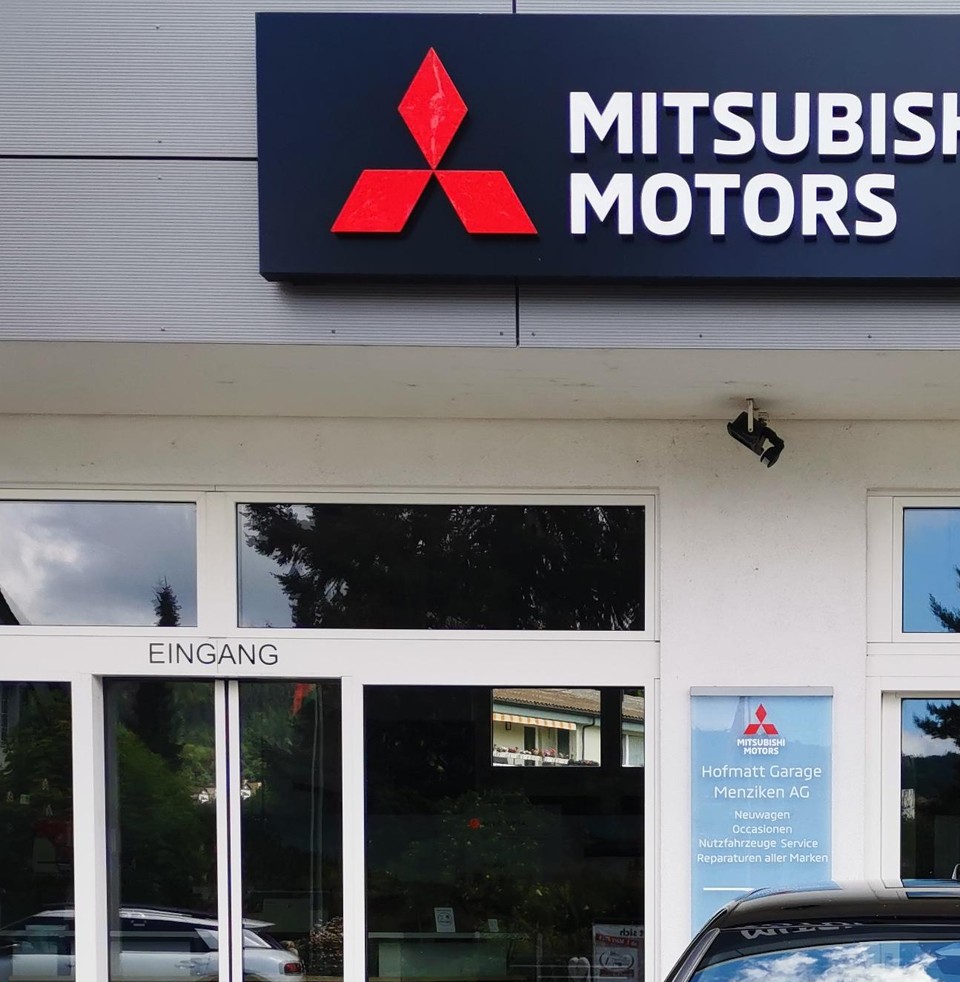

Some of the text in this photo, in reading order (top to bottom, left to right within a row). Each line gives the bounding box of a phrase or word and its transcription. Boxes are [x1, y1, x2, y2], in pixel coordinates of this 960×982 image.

[570, 172, 898, 237] MOTORS
[149, 642, 279, 665] EINGANG
[736, 738, 786, 747] MITSUBISHI
[743, 747, 779, 755] MOTORS
[701, 765, 822, 781] Hofmatt Garage
[714, 785, 810, 799] Menziken AG
[734, 810, 790, 823] Neuwagen
[732, 824, 793, 834] Occasionen
[698, 838, 819, 850] Nutzfahrzeuge Service
[697, 853, 828, 864] Reparaturen aller Marken
